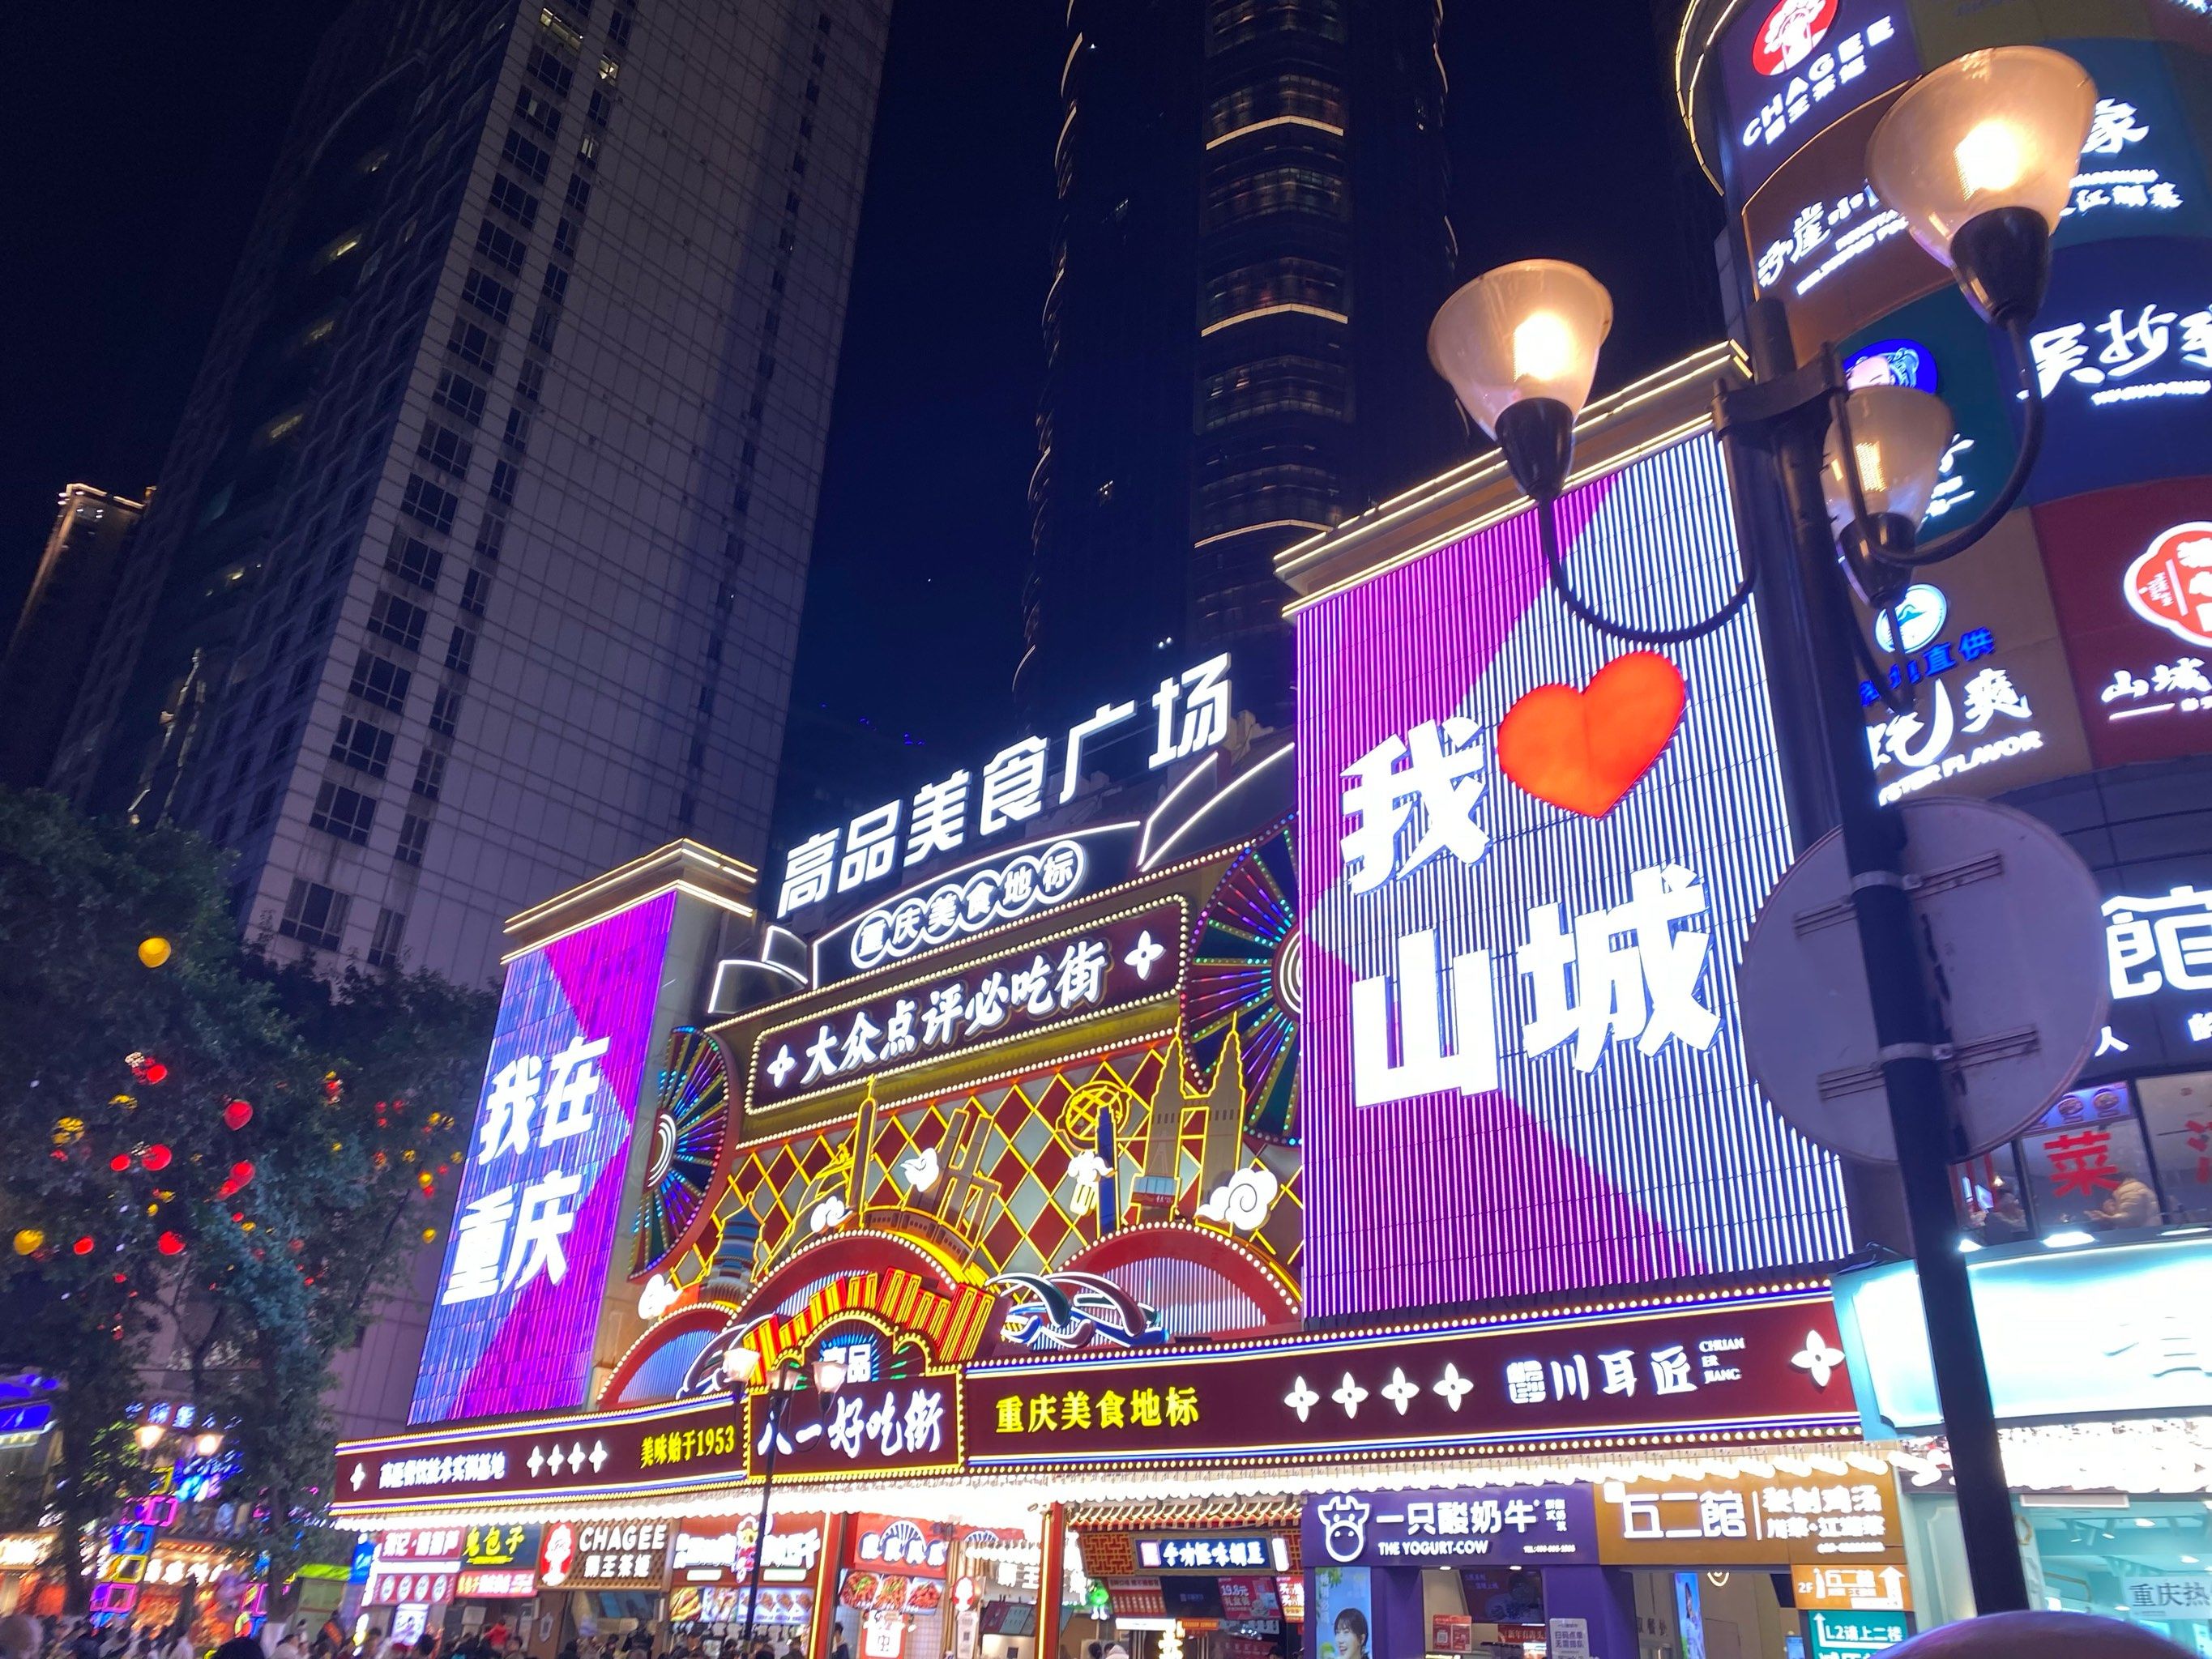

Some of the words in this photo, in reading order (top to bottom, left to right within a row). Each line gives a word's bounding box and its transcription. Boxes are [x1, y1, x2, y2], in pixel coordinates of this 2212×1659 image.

[1743, 15, 1894, 147] CHAGEE
[1942, 730, 2043, 778] FLAVOR
[777, 652, 1231, 918] 高品美食广场
[1340, 717, 1490, 895] 我
[856, 851, 1076, 957] 重庆美食地标
[1352, 864, 1723, 1108] 山城
[801, 940, 1108, 1085] 大众点评必吃街
[479, 1036, 610, 1165] 我在
[2044, 1131, 2122, 1198] 菜
[442, 1170, 583, 1306] 重庆
[1698, 1337, 1745, 1353] CHUAN
[1702, 1354, 1719, 1367] ER
[1550, 1345, 1697, 1401] 川耳匠
[1704, 1368, 1741, 1384] JIANG
[757, 1388, 944, 1459] 八一好吃街
[995, 1386, 1199, 1434] 重庆美食地标
[640, 1425, 735, 1469] 美味始于1953
[579, 1525, 667, 1552] CHAGEE
[1376, 1499, 1537, 1534] 一只酸奶牛
[1378, 1541, 1400, 1555] THE
[1403, 1540, 1488, 1556] YOGURT-COW
[1798, 1582, 1813, 1593] 2F
[1826, 1625, 1902, 1642] L2请上二楼
